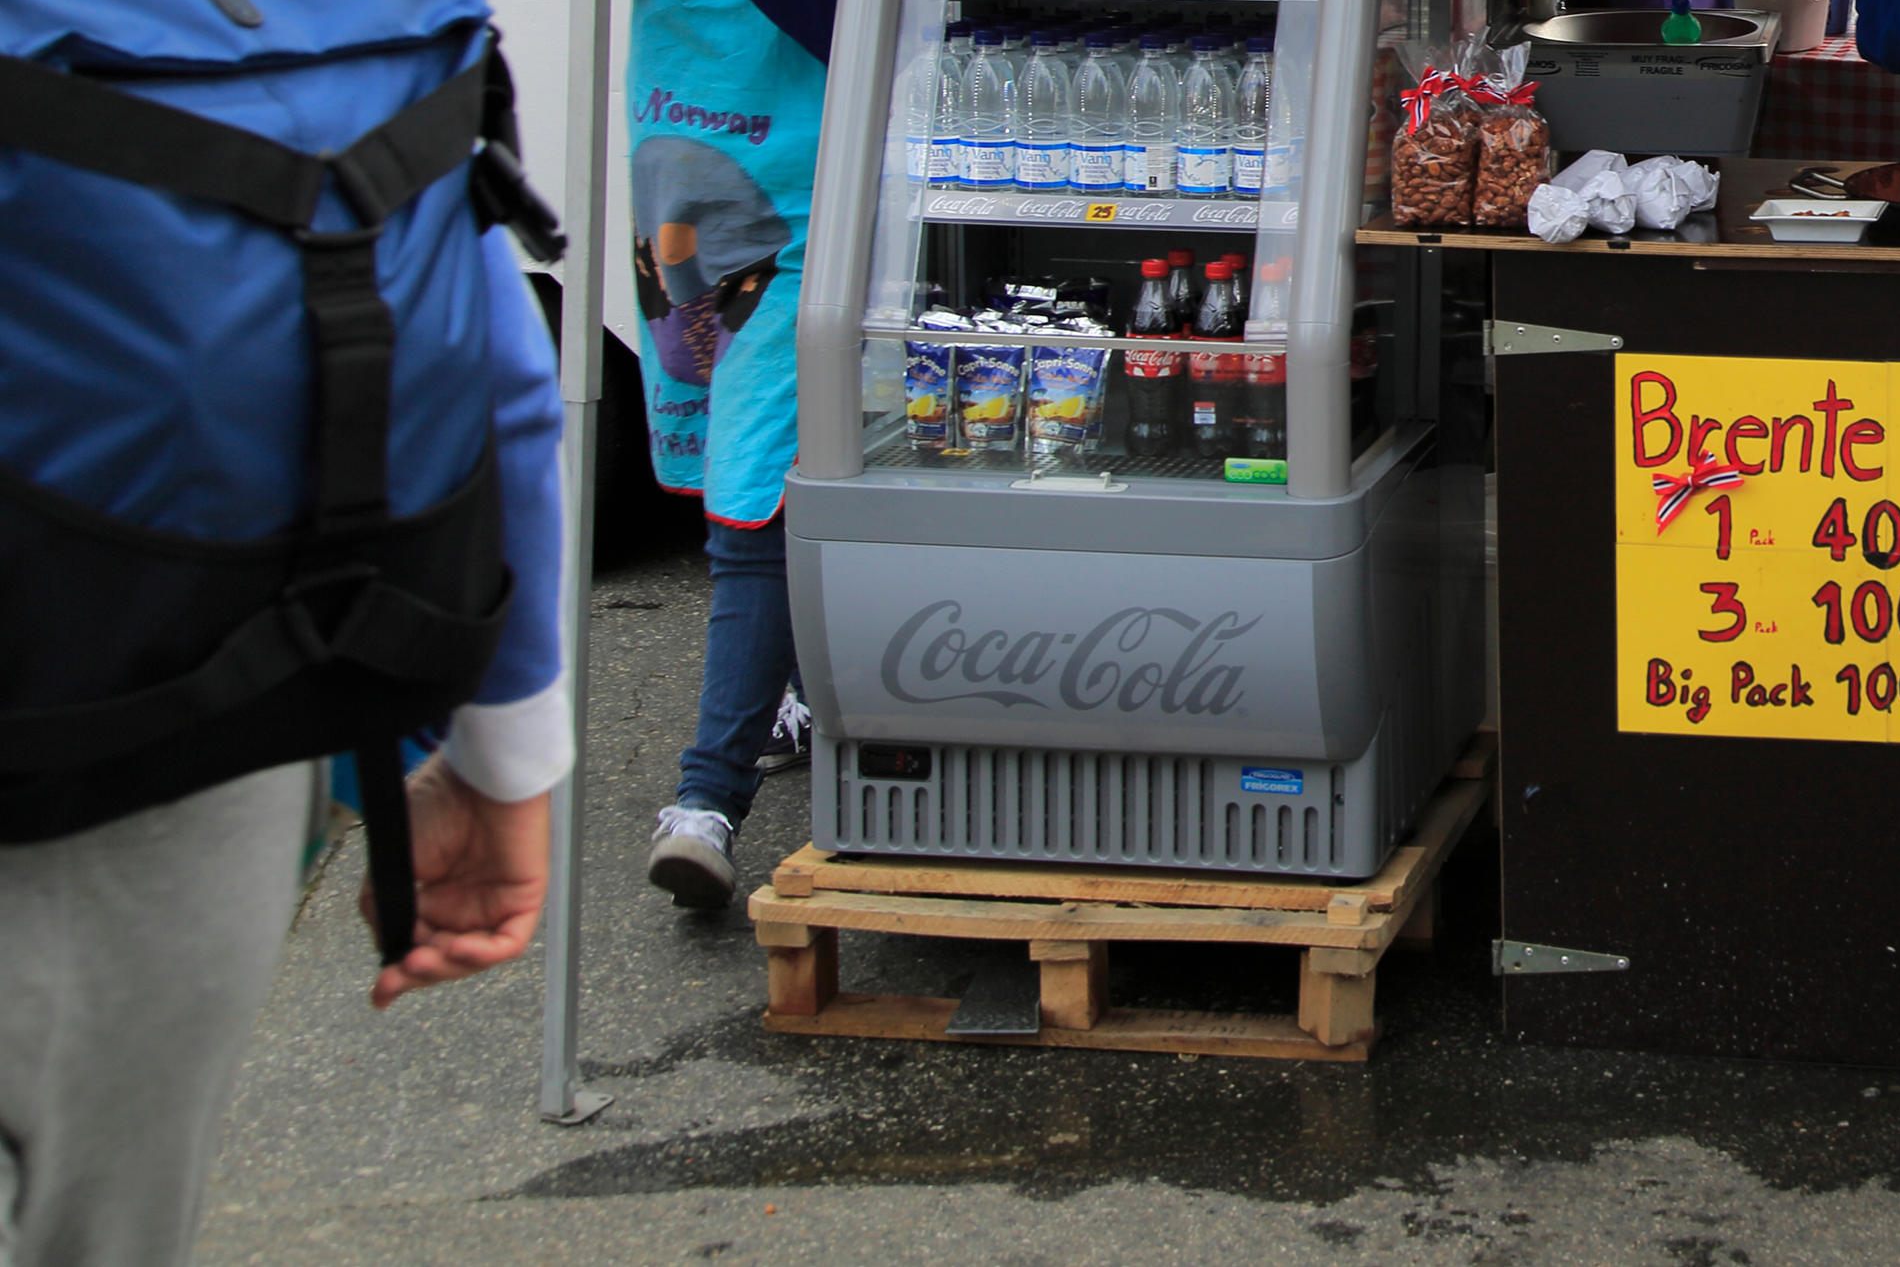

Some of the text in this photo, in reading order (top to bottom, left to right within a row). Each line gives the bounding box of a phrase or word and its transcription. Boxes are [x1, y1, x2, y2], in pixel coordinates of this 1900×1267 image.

[1640, 66, 1683, 75] FRAGILE
[633, 88, 771, 144] Norway
[928, 195, 999, 215] Coca-Cola
[1016, 199, 1086, 219] Coca-Cola
[1091, 206, 1113, 219] 25
[1630, 370, 1886, 481] Brente
[1704, 494, 1732, 560] 1
[1749, 529, 1775, 546] Pack
[1697, 581, 1747, 643] 3
[1754, 620, 1778, 634] Pack
[880, 598, 1265, 716] Coca-Cola
[1646, 658, 1712, 724] Big
[1731, 662, 1815, 708] Pack
